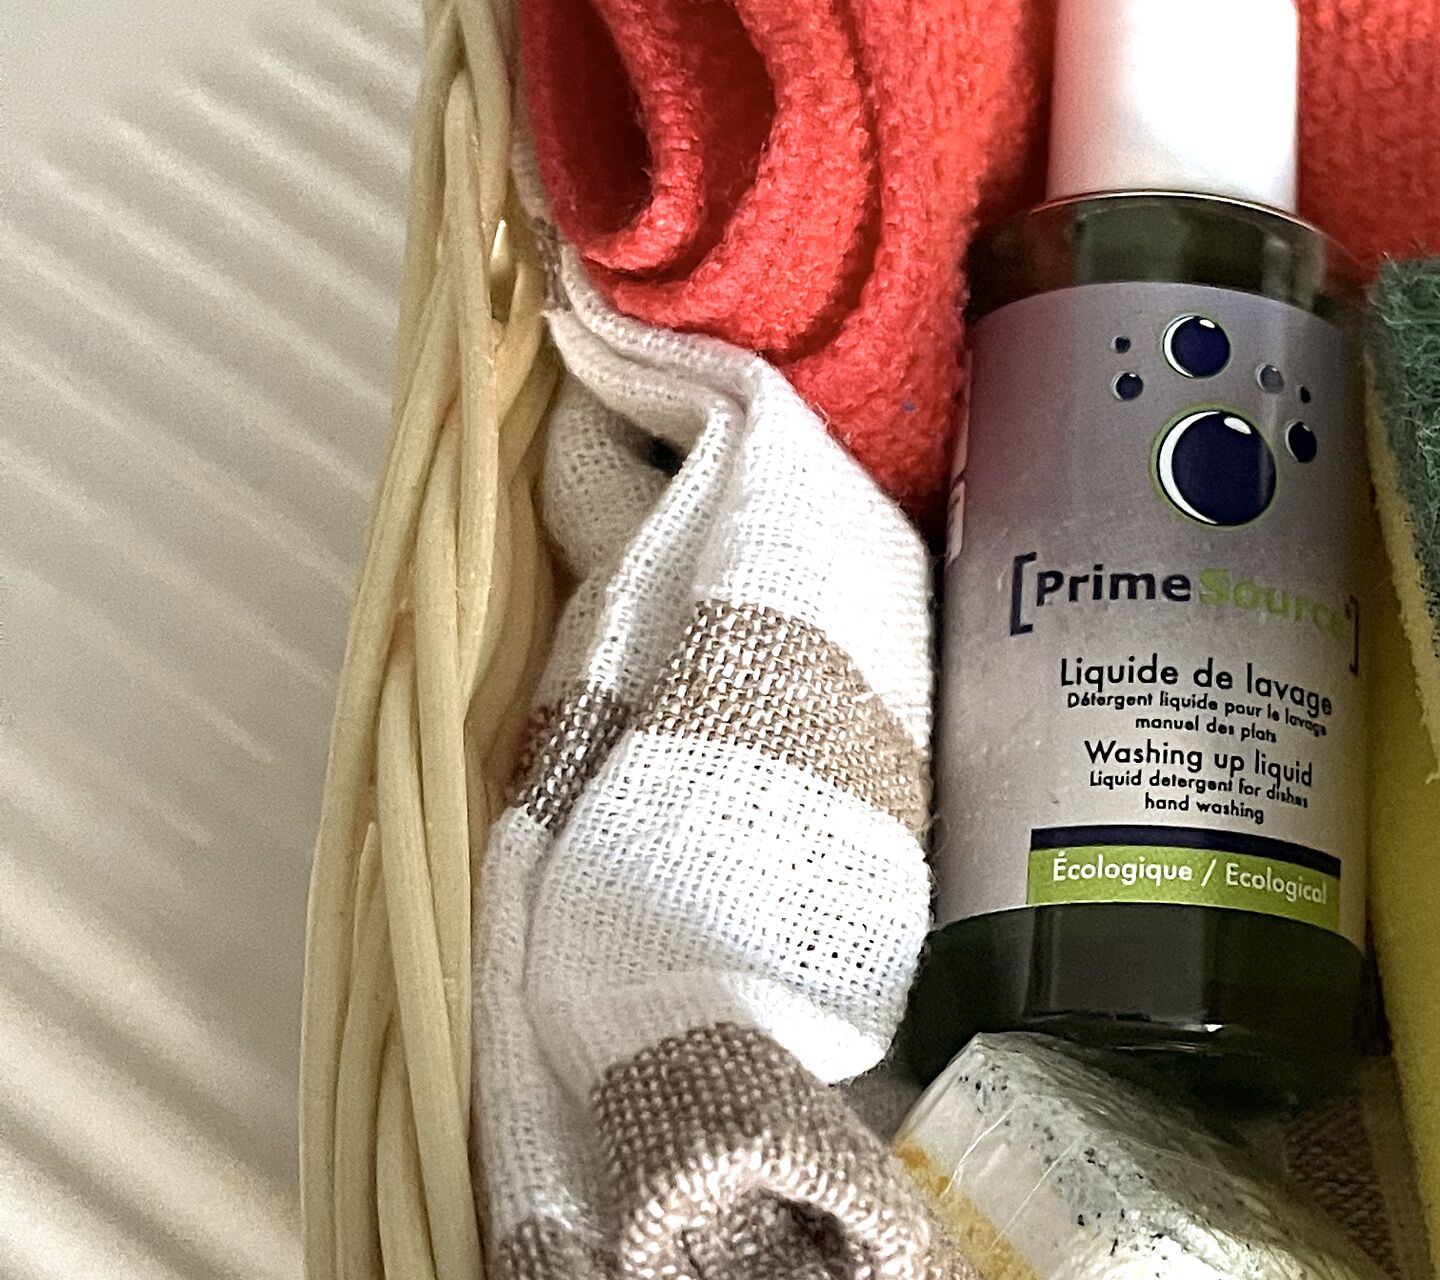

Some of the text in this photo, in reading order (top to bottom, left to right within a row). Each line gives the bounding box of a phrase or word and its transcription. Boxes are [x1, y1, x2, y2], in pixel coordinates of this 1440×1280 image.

[1061, 652, 1332, 719] Liquide de lavage
[1067, 691, 1153, 711] Détergent
[1159, 690, 1218, 713] liquide
[1224, 702, 1263, 718] pour
[1267, 703, 1280, 721] le
[1135, 714, 1199, 731] manuel
[1206, 716, 1235, 735] des
[1084, 738, 1313, 789] Washing up liquid
[1090, 769, 1142, 790] Liquid
[1149, 769, 1233, 794] detergent
[1239, 777, 1262, 796] for
[1145, 791, 1265, 825] hand washing
[1052, 851, 1193, 886] Écologique
[1225, 862, 1328, 905] Ecological
